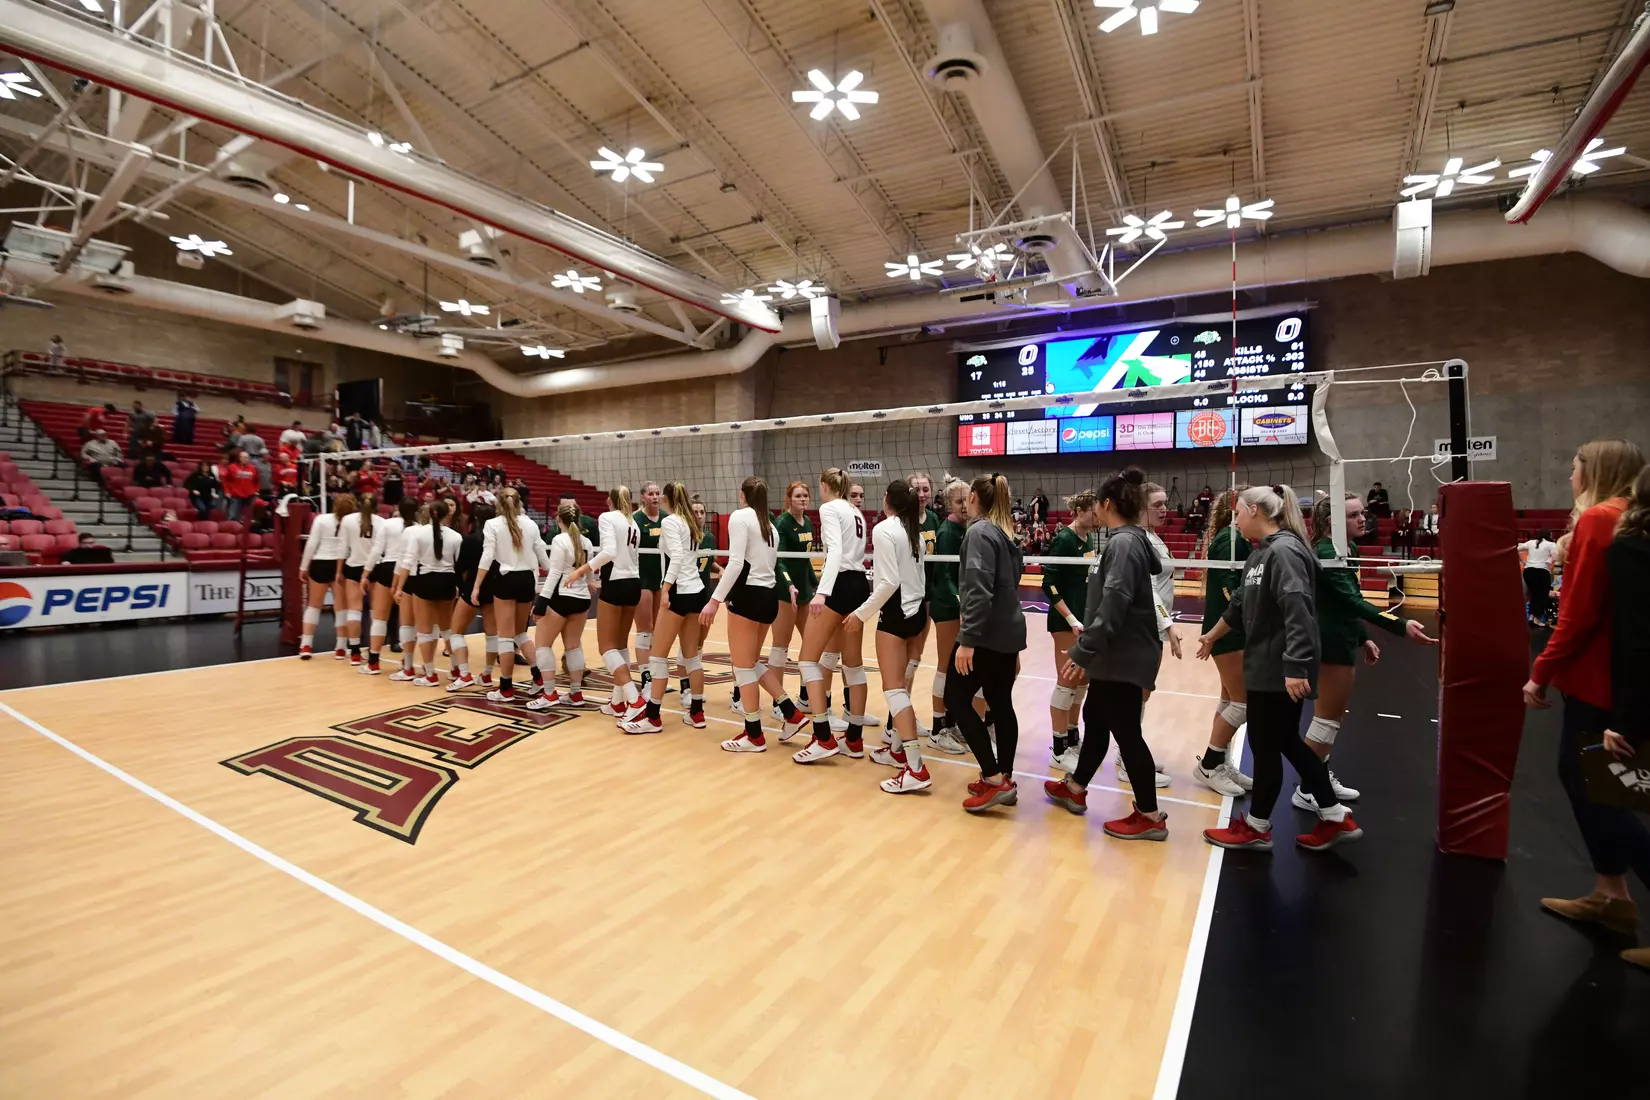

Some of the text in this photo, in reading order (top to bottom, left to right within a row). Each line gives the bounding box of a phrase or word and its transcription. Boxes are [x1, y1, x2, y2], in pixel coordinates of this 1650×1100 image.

[1234, 345, 1263, 356] KILLS
[1223, 355, 1264, 367] ATTACK
[970, 370, 983, 381] 17
[1226, 364, 1270, 376] ASSISTS
[1226, 394, 1269, 405] BLOCKS
[1255, 417, 1292, 425] CABINETS
[1078, 428, 1110, 441] pepsi
[1119, 424, 1135, 434] 3D
[968, 447, 993, 455] TOYOTA
[849, 462, 880, 470] molten
[854, 515, 863, 539] 6
[626, 526, 637, 549] 14
[195, 583, 236, 601] THE
[41, 583, 170, 616] PEPSI
